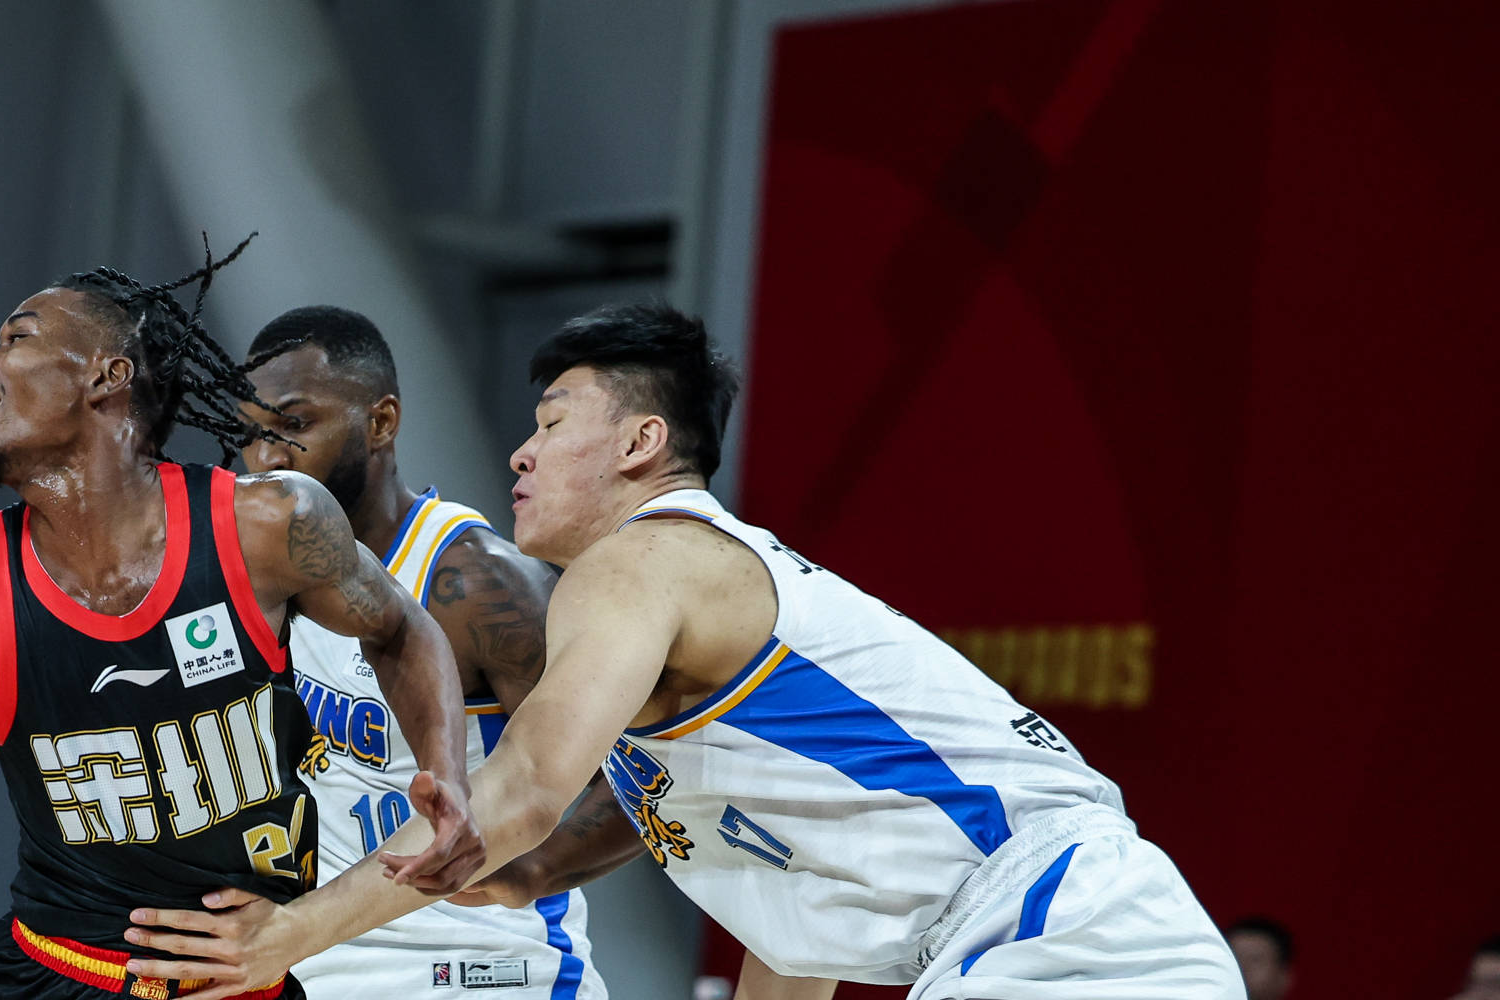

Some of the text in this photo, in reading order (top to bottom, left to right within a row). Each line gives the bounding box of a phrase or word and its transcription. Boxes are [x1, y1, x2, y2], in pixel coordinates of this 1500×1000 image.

[183, 648, 234, 671] 中国人寿
[186, 659, 237, 679] CHINA LIFE
[355, 665, 374, 678] CGB
[293, 668, 391, 772] ING
[30, 683, 282, 845] 深圳
[716, 803, 793, 871] 17
